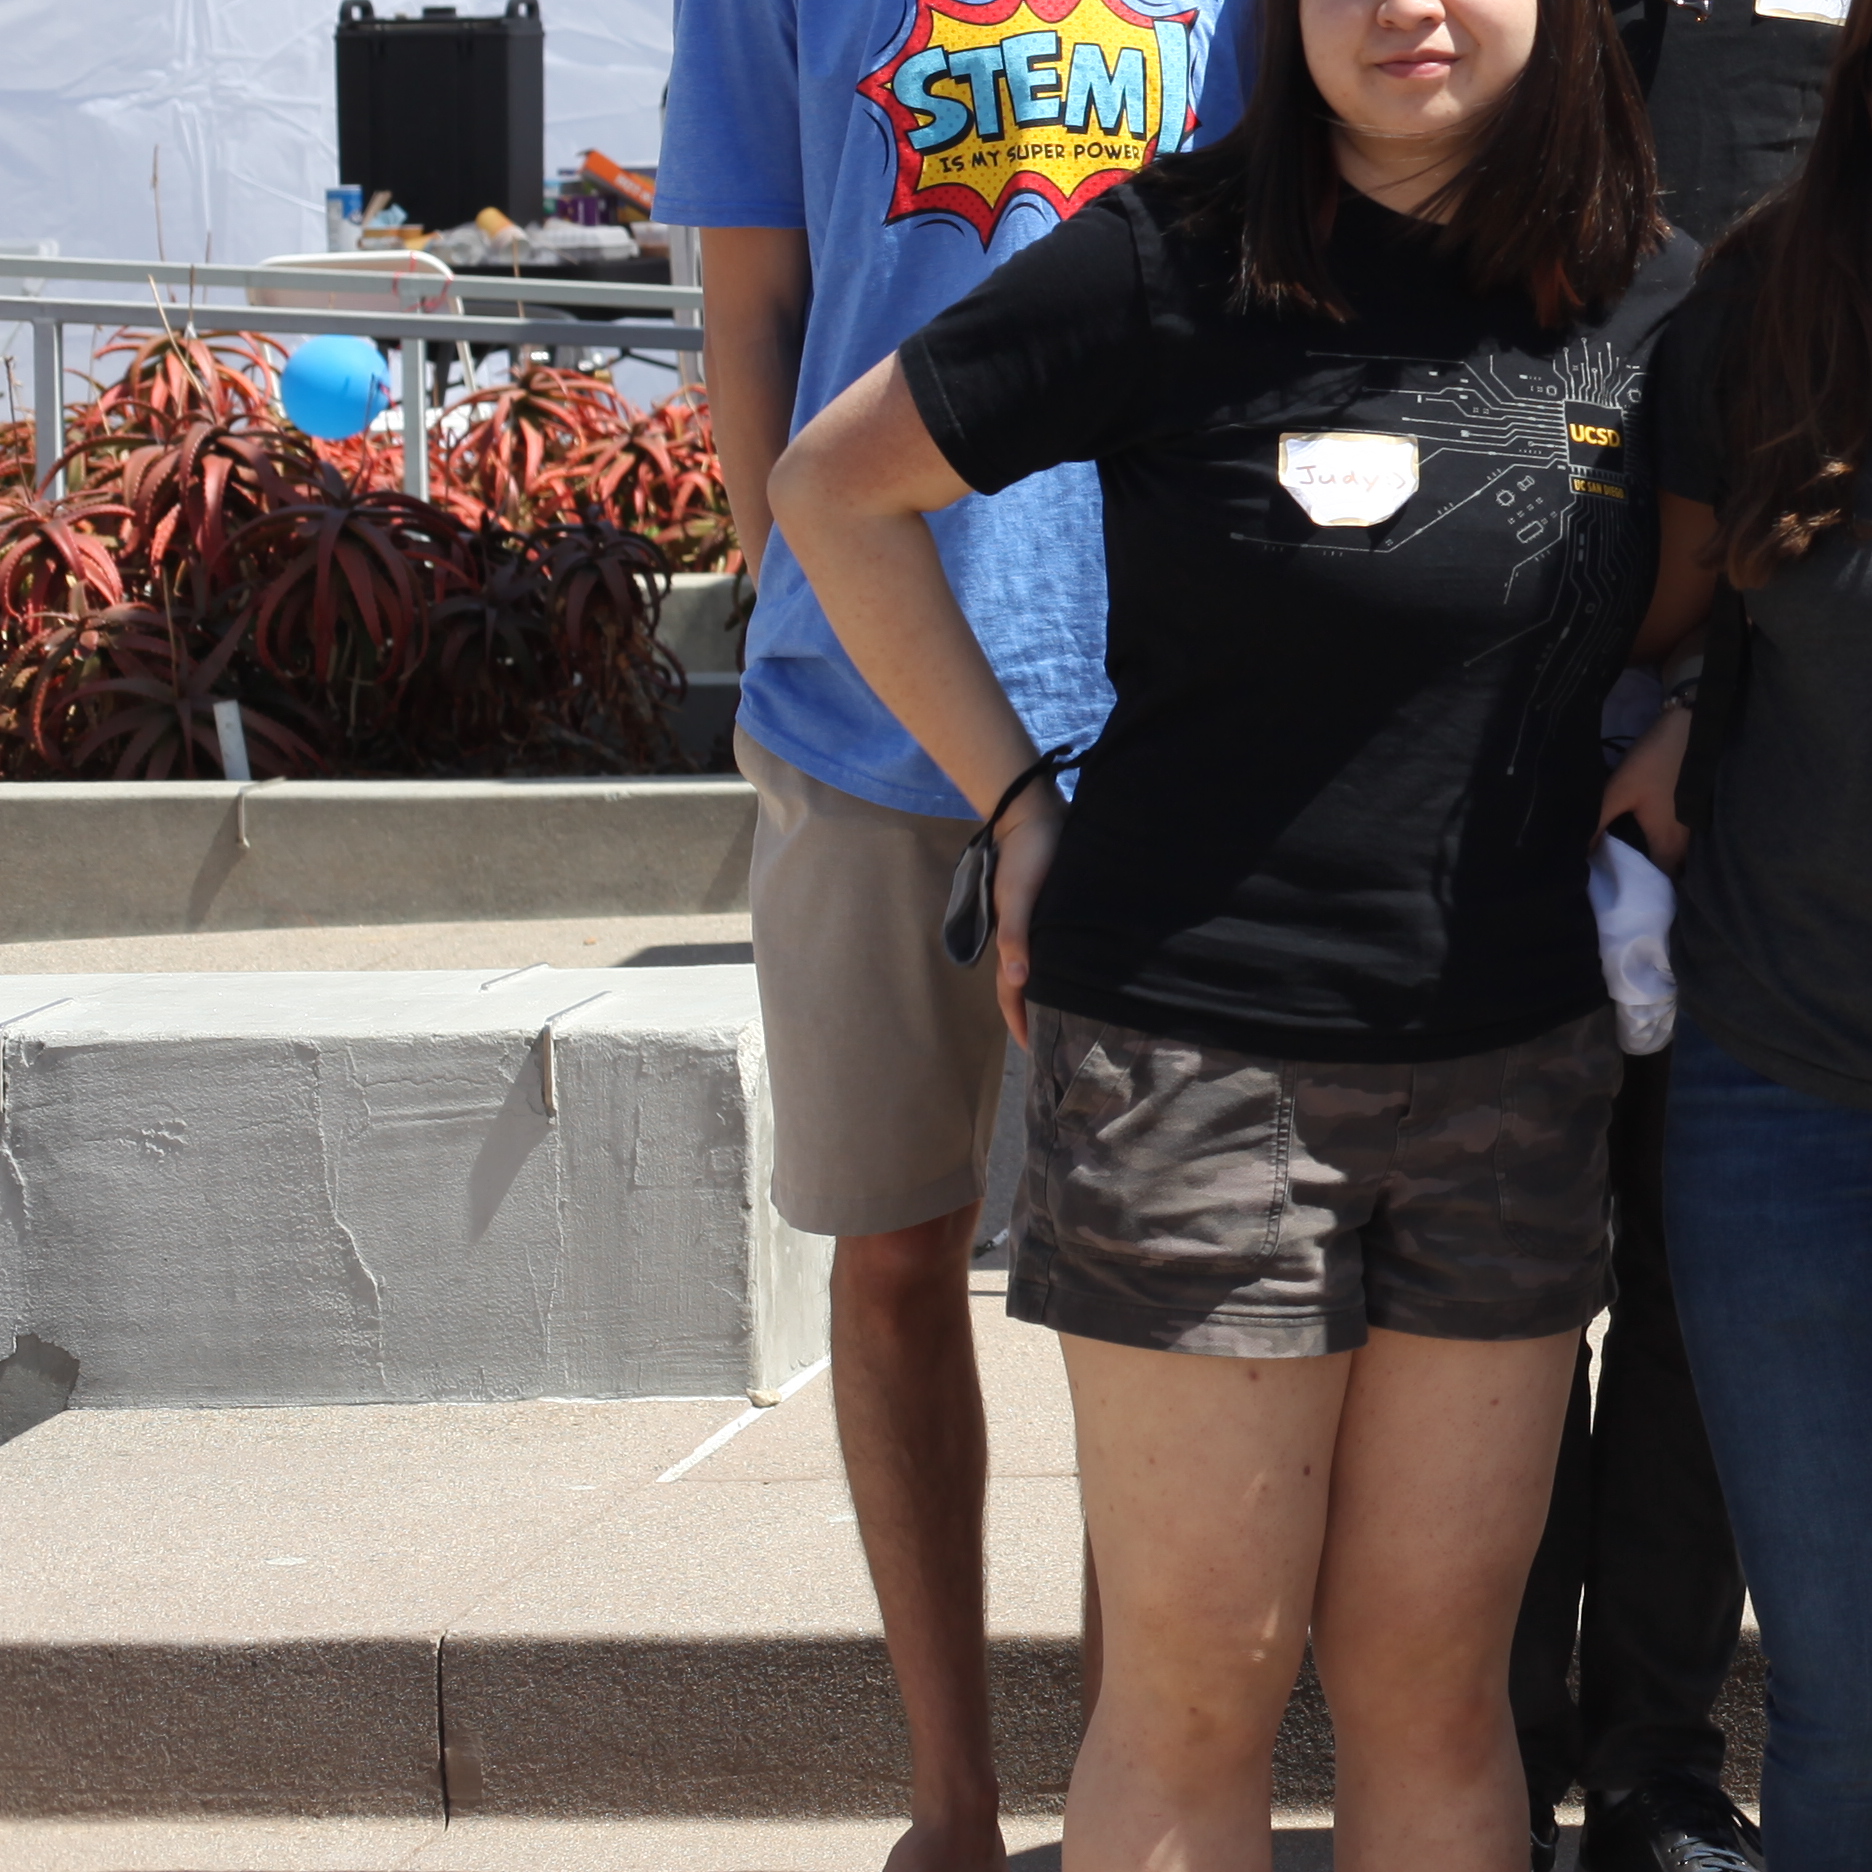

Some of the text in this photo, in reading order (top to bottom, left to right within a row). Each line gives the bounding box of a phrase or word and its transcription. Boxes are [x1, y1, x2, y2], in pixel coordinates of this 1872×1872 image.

[940, 140, 1143, 174] IS MY SUPER POWER
[1569, 422, 1621, 448] UCSD
[1295, 464, 1379, 493] Judy
[1573, 478, 1626, 500] UC SAN DIEGO
